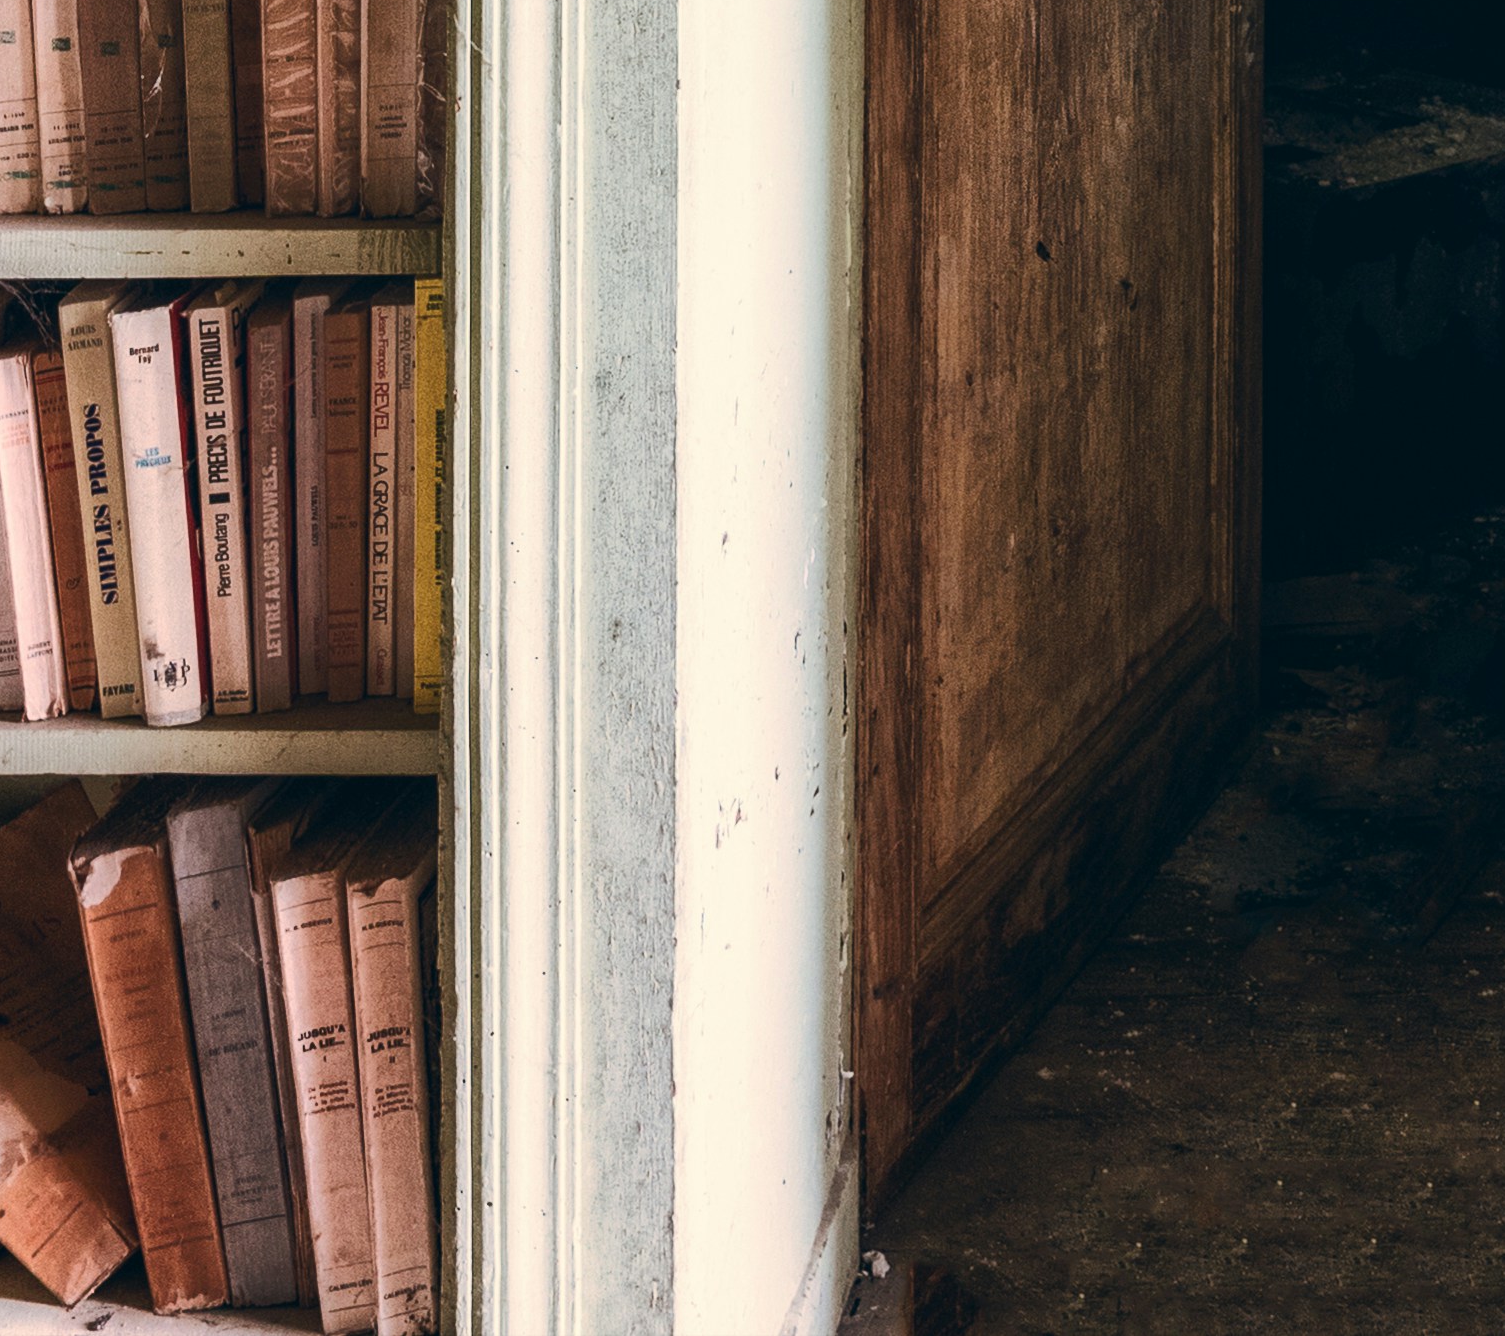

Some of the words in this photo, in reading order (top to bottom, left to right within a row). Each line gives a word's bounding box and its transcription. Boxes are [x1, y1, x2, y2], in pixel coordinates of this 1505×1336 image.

[199, 319, 225, 405] FOUTRIQUET
[204, 410, 225, 430] DE
[83, 403, 107, 495] PROPOS
[205, 435, 229, 483] PRECIS
[373, 453, 388, 473] LA
[373, 477, 388, 533] GRACE
[93, 505, 119, 605] SIMPLES
[213, 513, 232, 561] Boutang
[373, 542, 387, 566] DE
[215, 563, 232, 597] Pierre
[372, 571, 387, 624] L'ETAT
